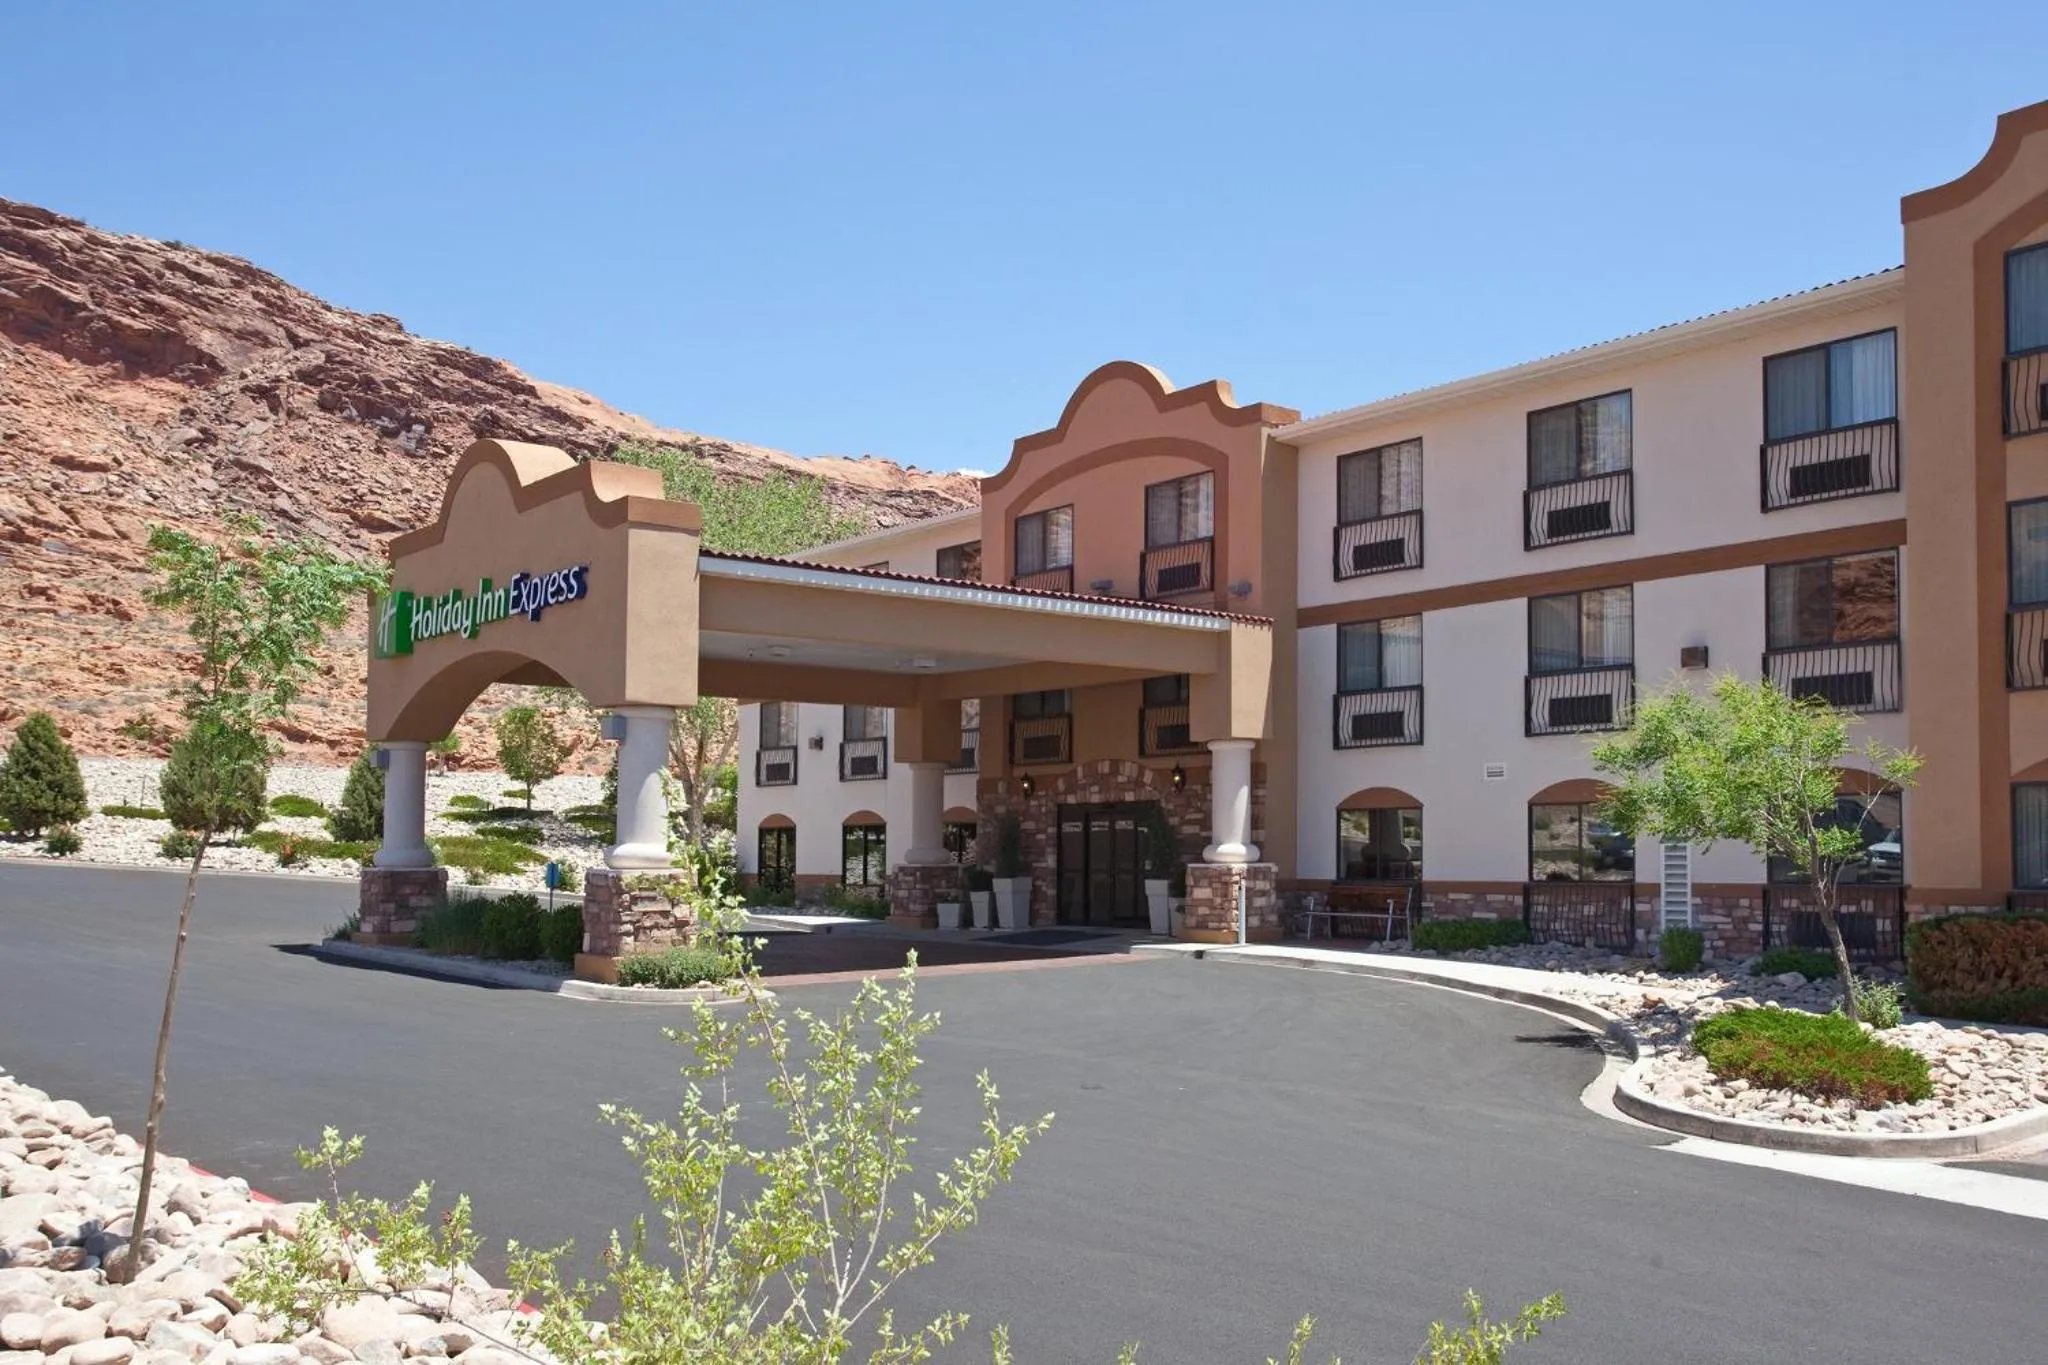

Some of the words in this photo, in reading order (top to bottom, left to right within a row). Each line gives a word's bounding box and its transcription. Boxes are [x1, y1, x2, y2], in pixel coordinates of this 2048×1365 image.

[410, 589, 474, 642] Holiday
[476, 578, 506, 624] Inn
[508, 565, 584, 620] Express
